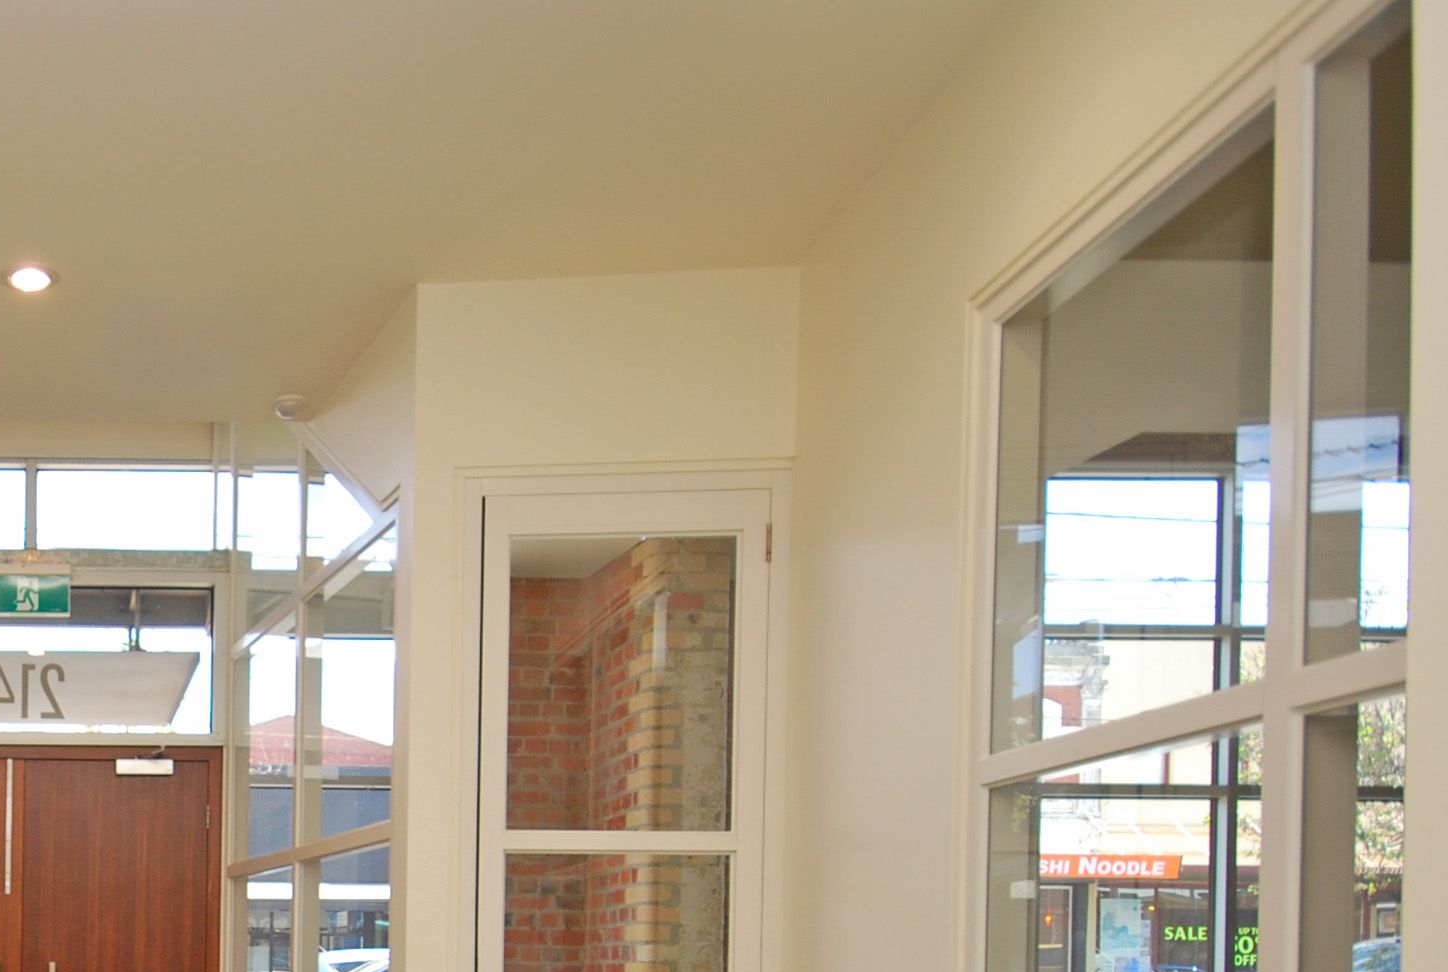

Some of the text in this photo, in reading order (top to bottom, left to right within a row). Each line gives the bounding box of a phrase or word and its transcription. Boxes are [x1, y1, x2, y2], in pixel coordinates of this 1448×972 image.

[1078, 856, 1166, 876] NOODLE
[1164, 926, 1208, 941] SALE
[1238, 927, 1251, 936] UP
[1234, 954, 1257, 967] OFF
